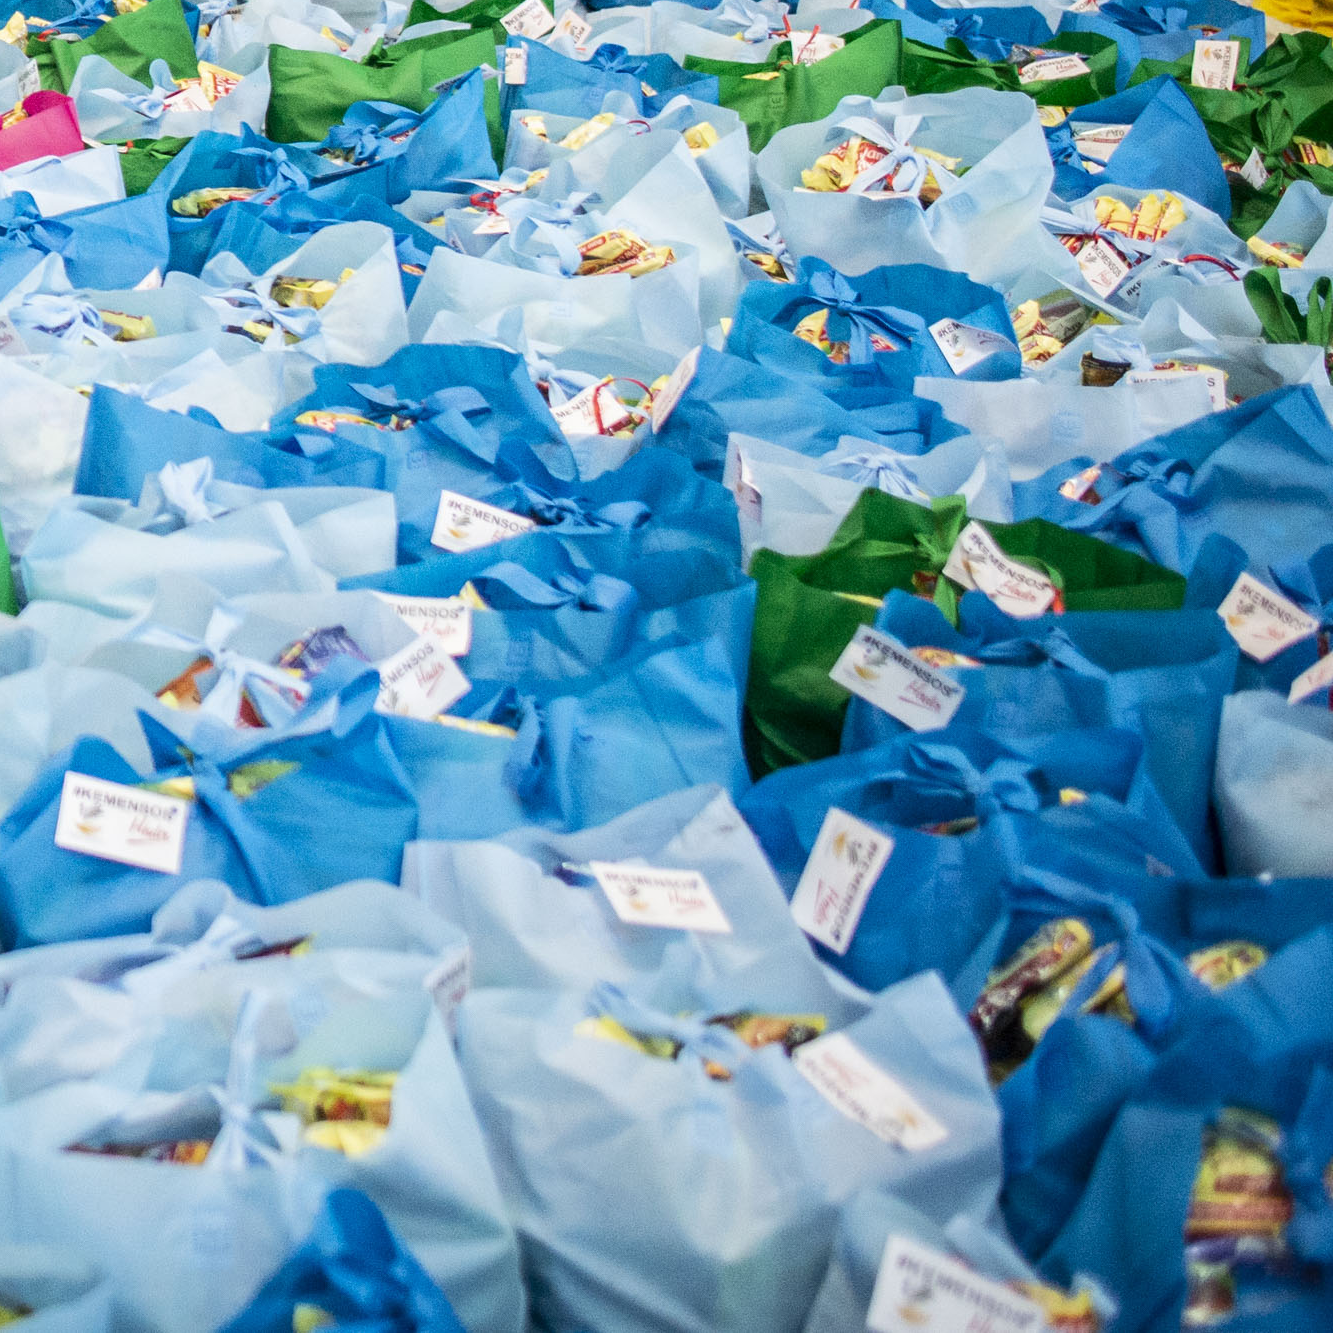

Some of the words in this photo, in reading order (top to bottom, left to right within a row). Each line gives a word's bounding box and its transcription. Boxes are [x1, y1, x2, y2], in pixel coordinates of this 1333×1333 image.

[1090, 243, 1122, 278] #KEMENSOS
[970, 532, 1049, 591] #KEMENSOS
[396, 605, 458, 620] MENSOS
[863, 634, 956, 698] #KEMENSOS
